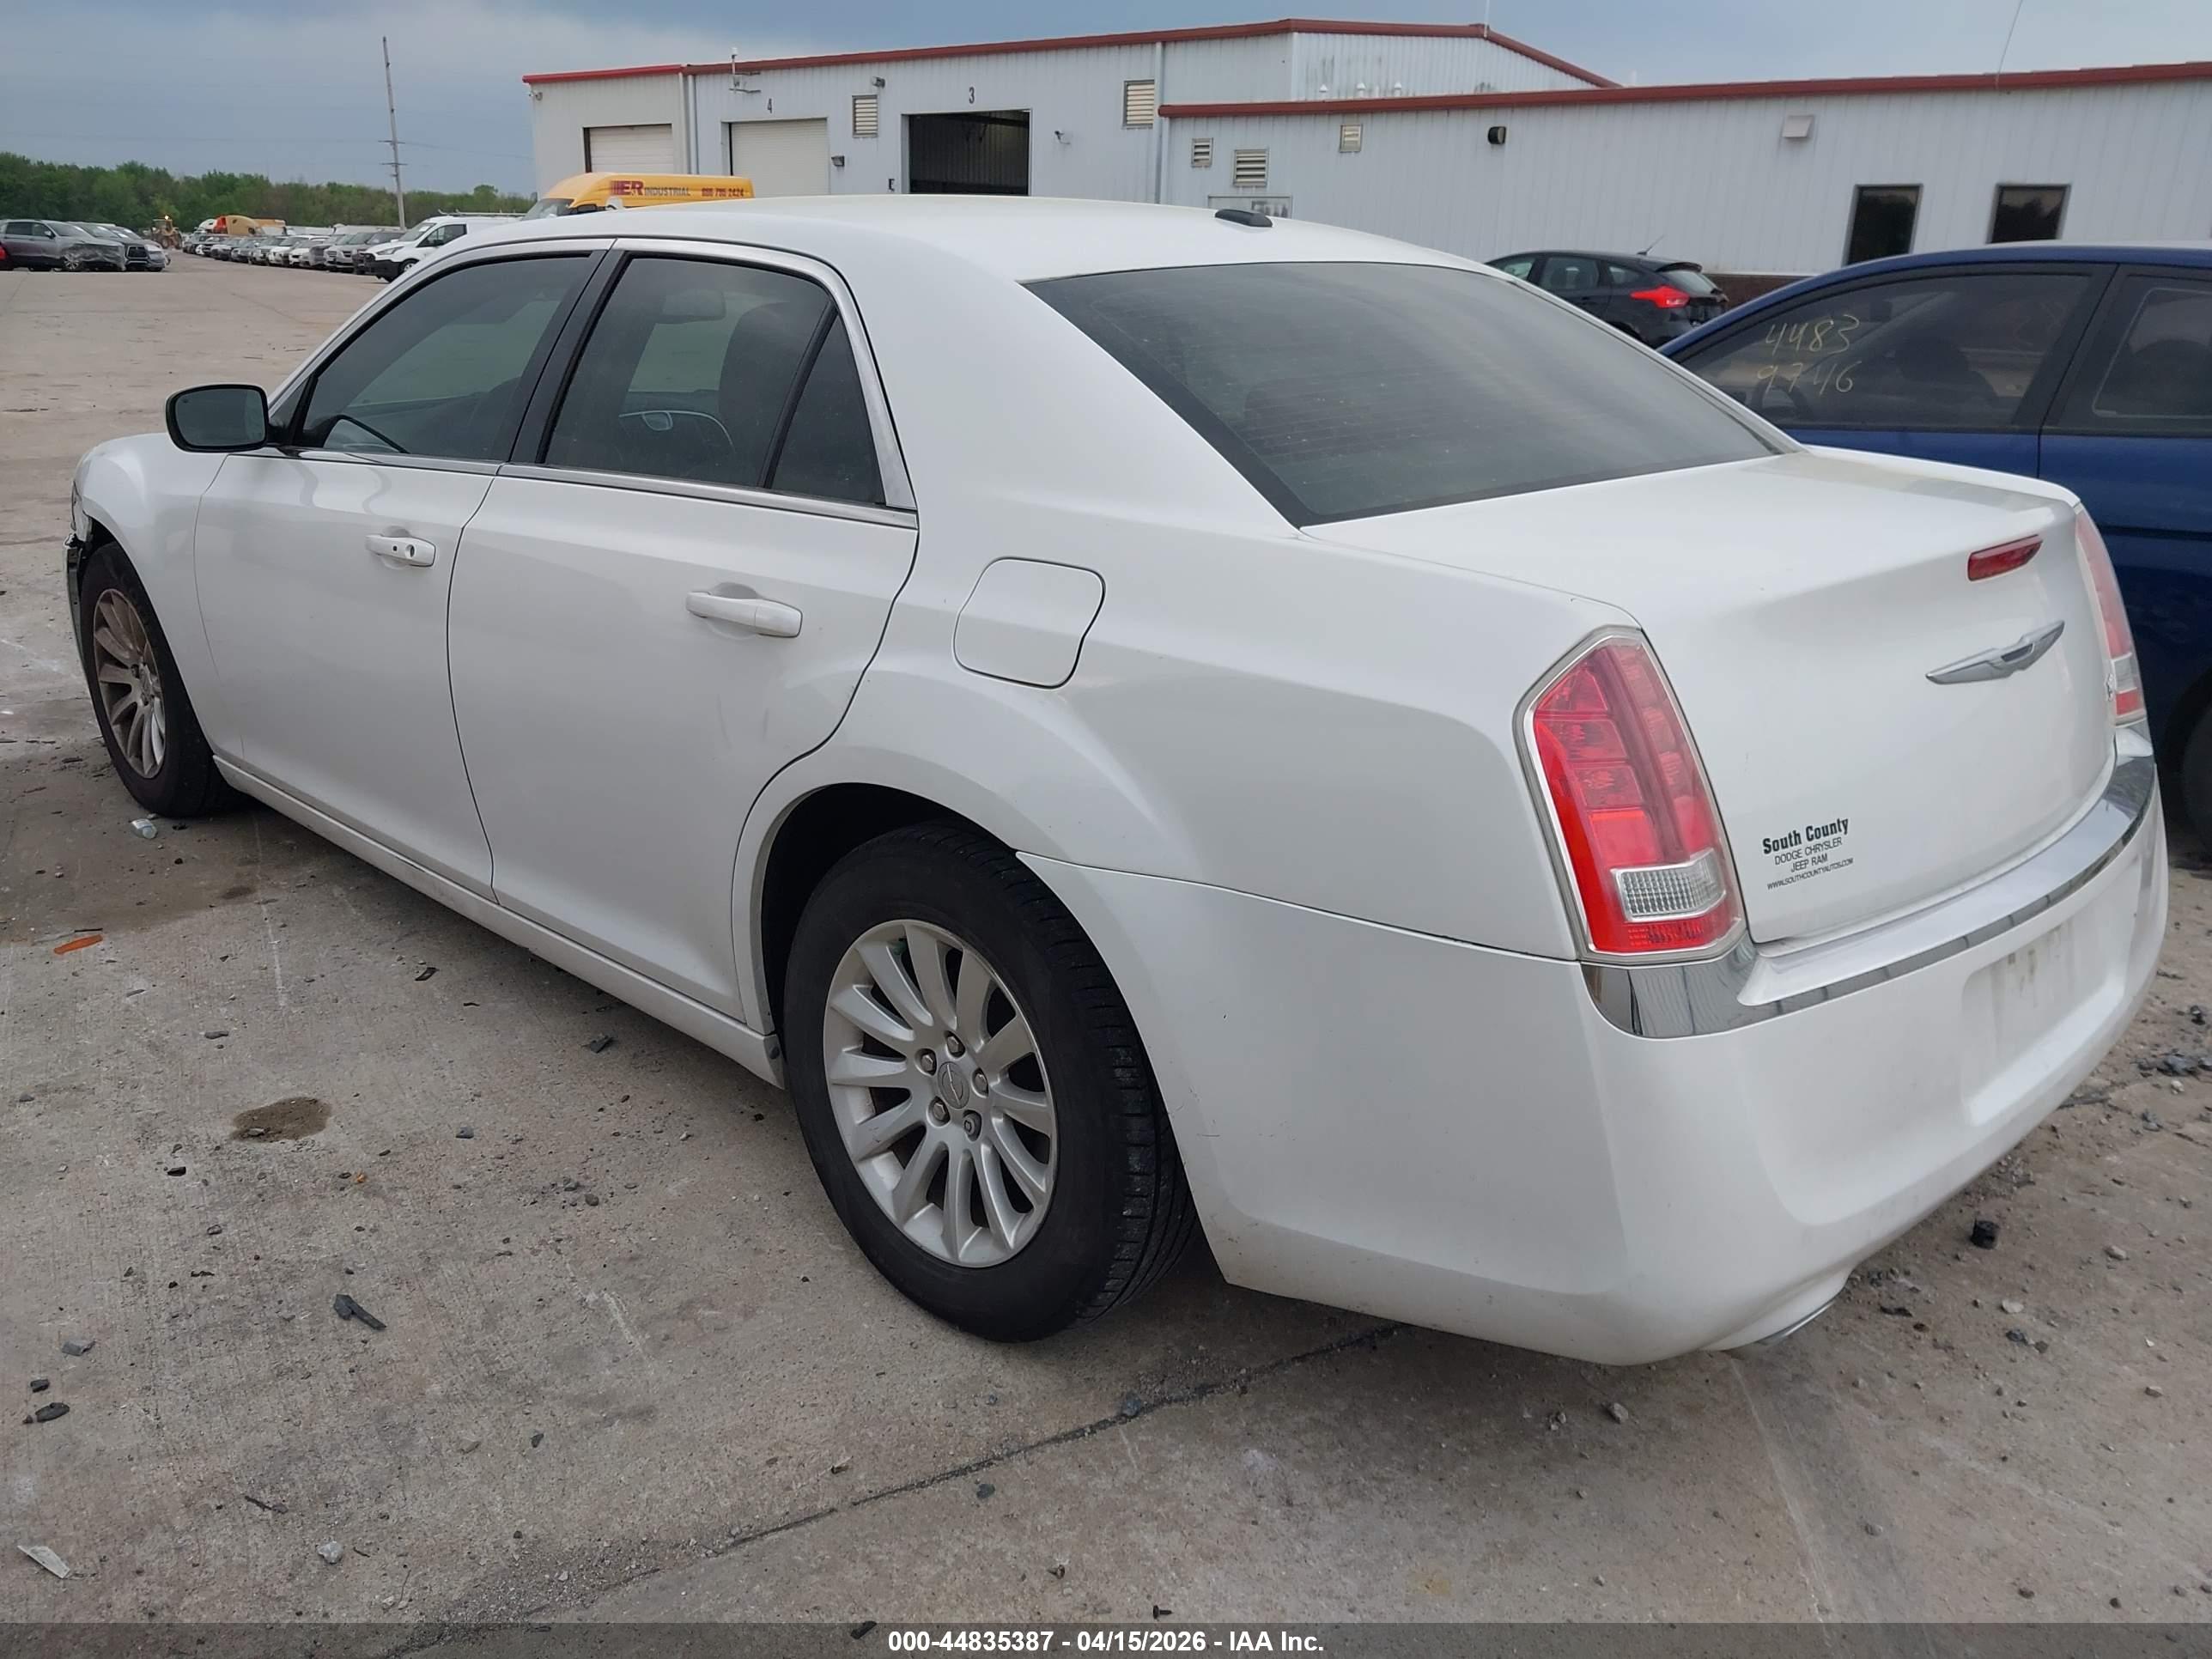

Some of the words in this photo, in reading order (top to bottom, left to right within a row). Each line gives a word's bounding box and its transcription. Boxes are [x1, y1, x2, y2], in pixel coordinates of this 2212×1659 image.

[767, 98, 773, 114] 4
[969, 86, 975, 104] 3
[644, 186, 690, 197] INDUSTRIAL
[1765, 314, 1860, 356] 4483
[1757, 361, 1863, 395] 9746
[1762, 830, 1802, 854] South
[1805, 817, 1849, 842] County
[1774, 848, 1803, 865] DODGE
[1804, 836, 1843, 856] CHRYSLER
[1790, 859, 1809, 873] JEEP
[1811, 853, 1828, 866] RAM
